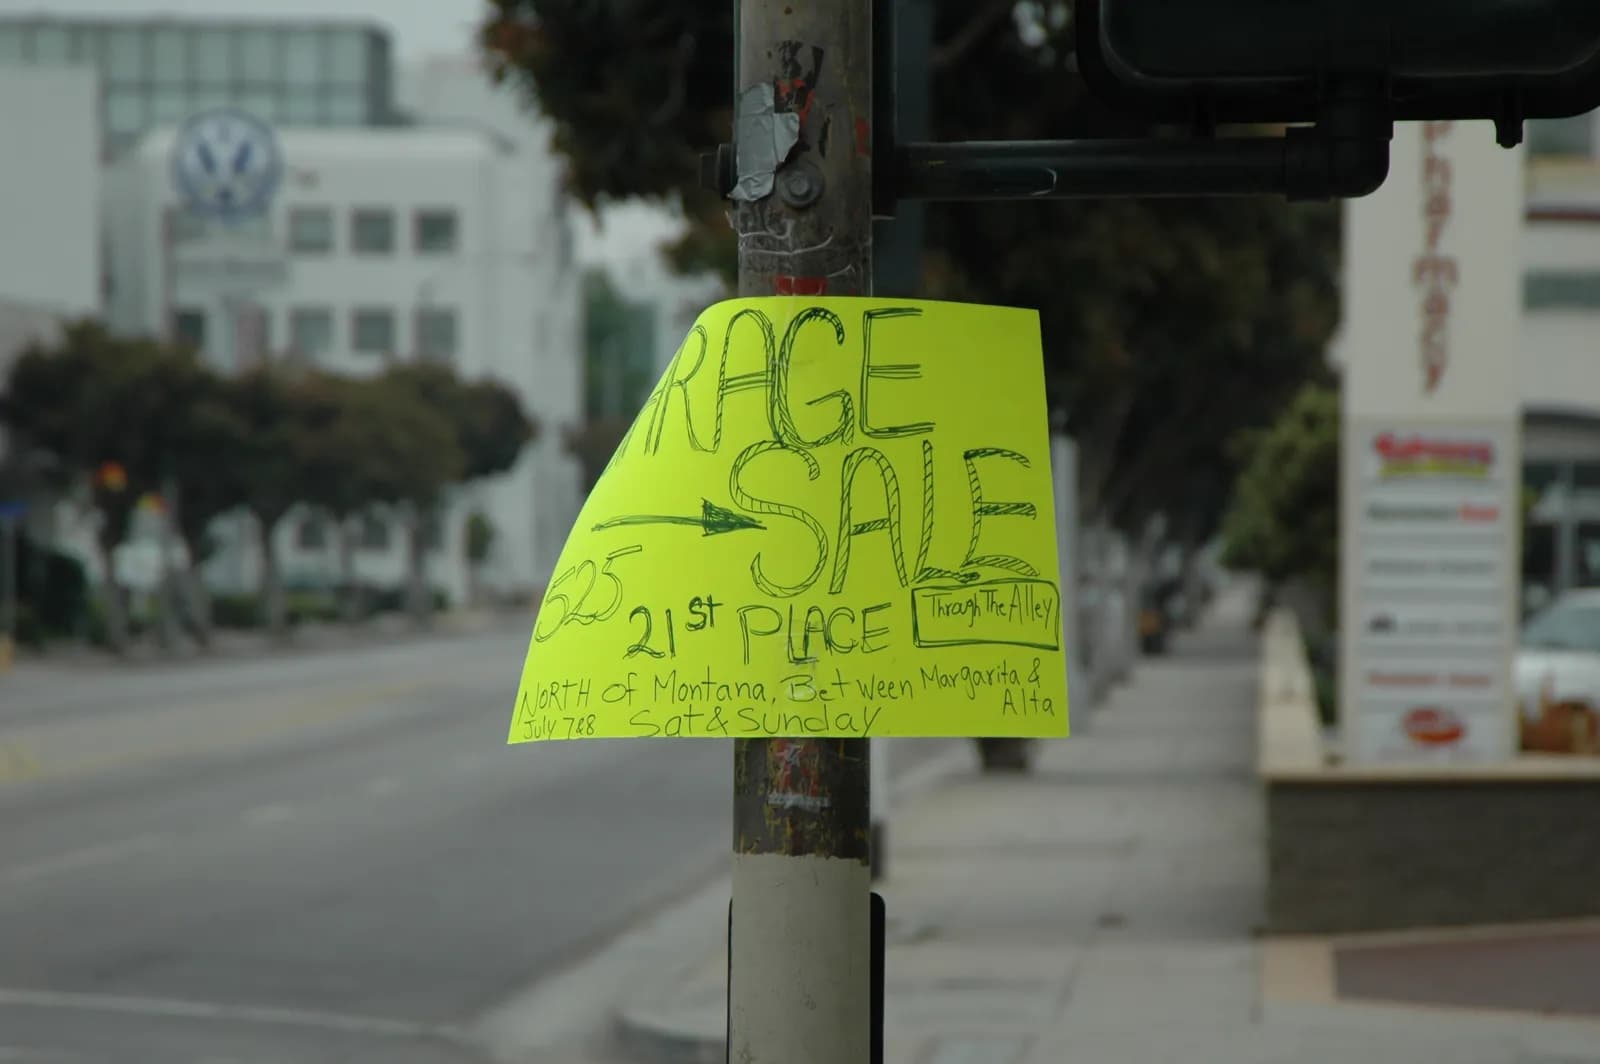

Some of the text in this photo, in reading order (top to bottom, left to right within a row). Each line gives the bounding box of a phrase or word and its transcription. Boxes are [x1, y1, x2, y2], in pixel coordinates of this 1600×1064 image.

[729, 439, 1041, 599] SALE
[534, 544, 643, 643] 525
[979, 588, 1006, 616] The
[1008, 583, 1053, 630] Alley
[623, 594, 893, 666] 21st PLACE
[920, 658, 1021, 701] Margarita
[1026, 657, 1042, 688] &
[1002, 687, 1055, 717] Alta
[524, 717, 556, 742] July
